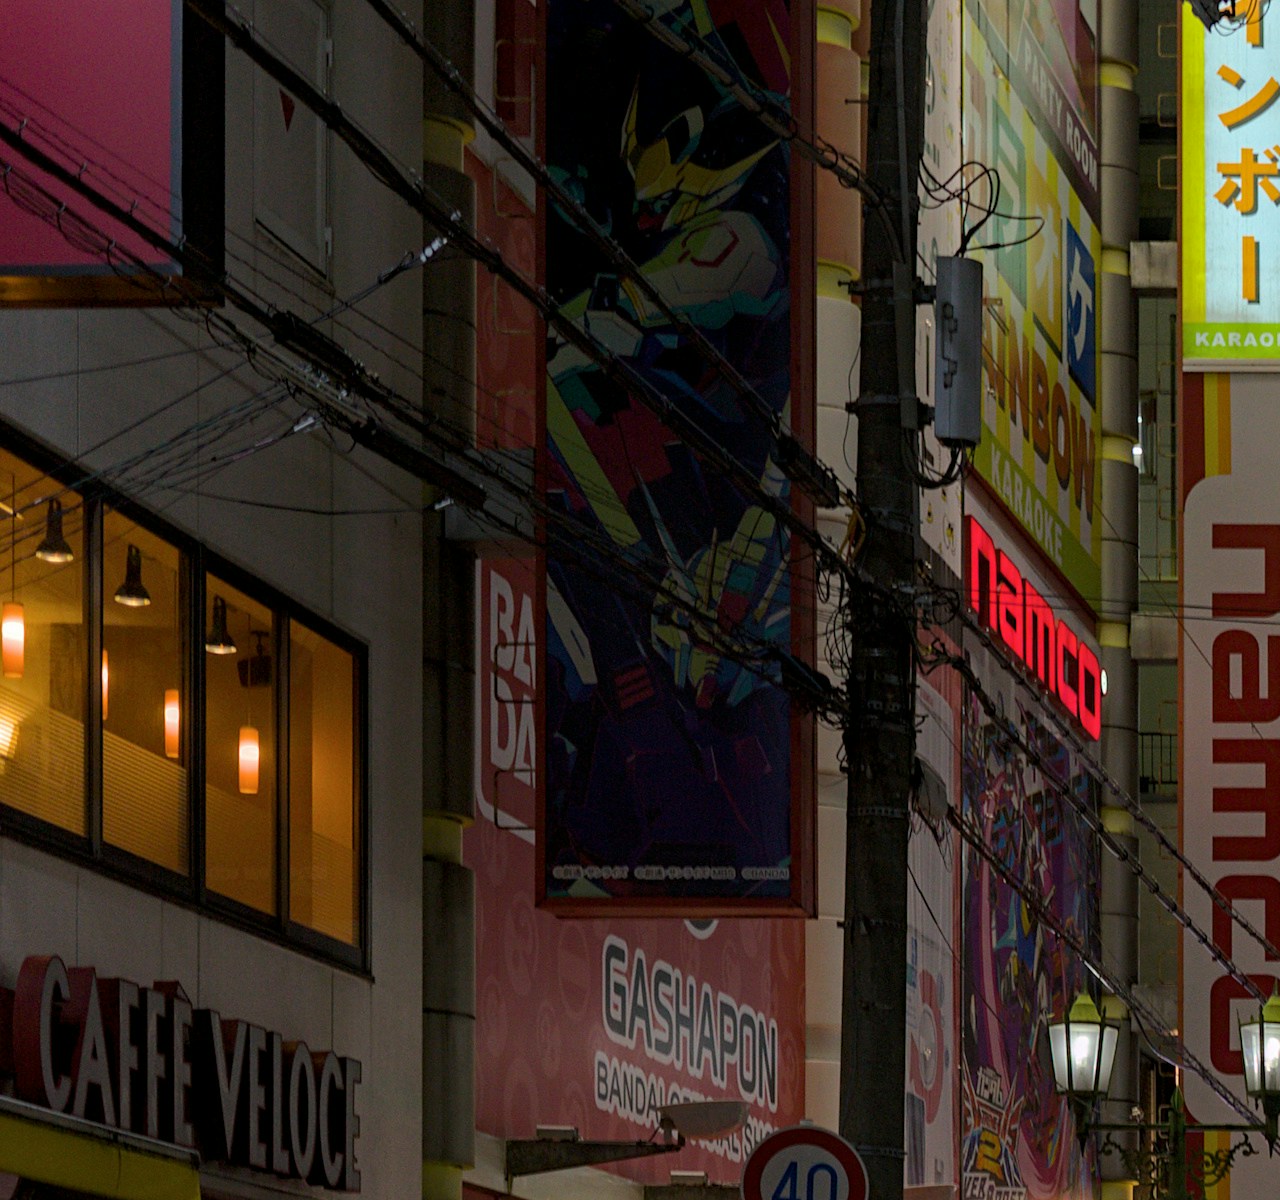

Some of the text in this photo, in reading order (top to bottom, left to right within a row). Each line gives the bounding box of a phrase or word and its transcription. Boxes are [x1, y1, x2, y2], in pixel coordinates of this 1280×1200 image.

[1023, 50, 1099, 191] PARTY ROOM
[990, 466, 1064, 563] KARAOKE
[966, 514, 1101, 741] namco
[207, 1010, 362, 1192] VELOCE
[603, 935, 778, 1112] GASHAPON
